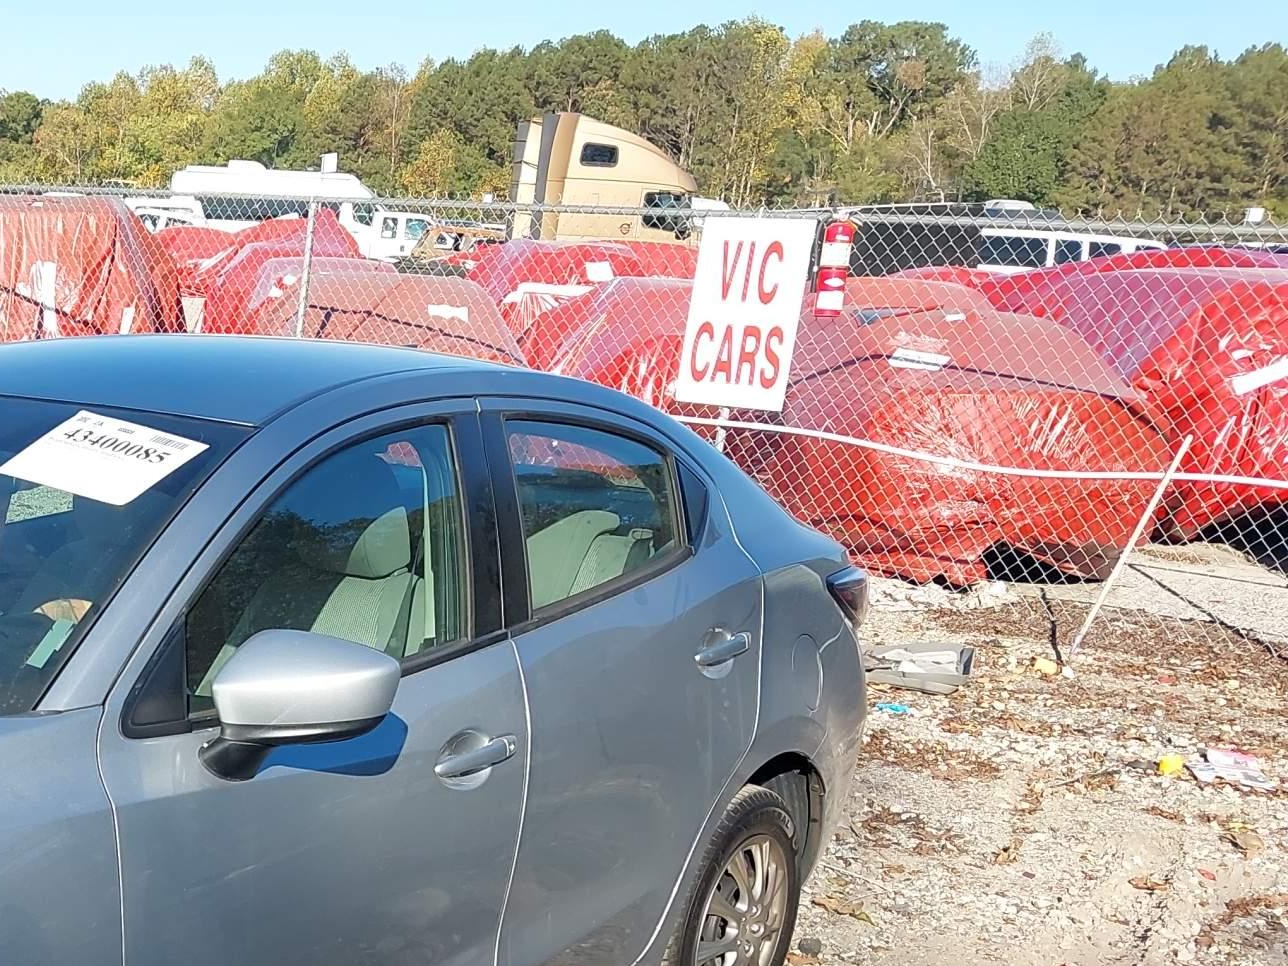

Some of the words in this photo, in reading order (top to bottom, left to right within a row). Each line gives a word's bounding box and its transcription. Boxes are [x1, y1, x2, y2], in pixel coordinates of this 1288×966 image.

[721, 239, 784, 304] VIC
[690, 321, 784, 389] CARS
[63, 428, 172, 463] 43400085
